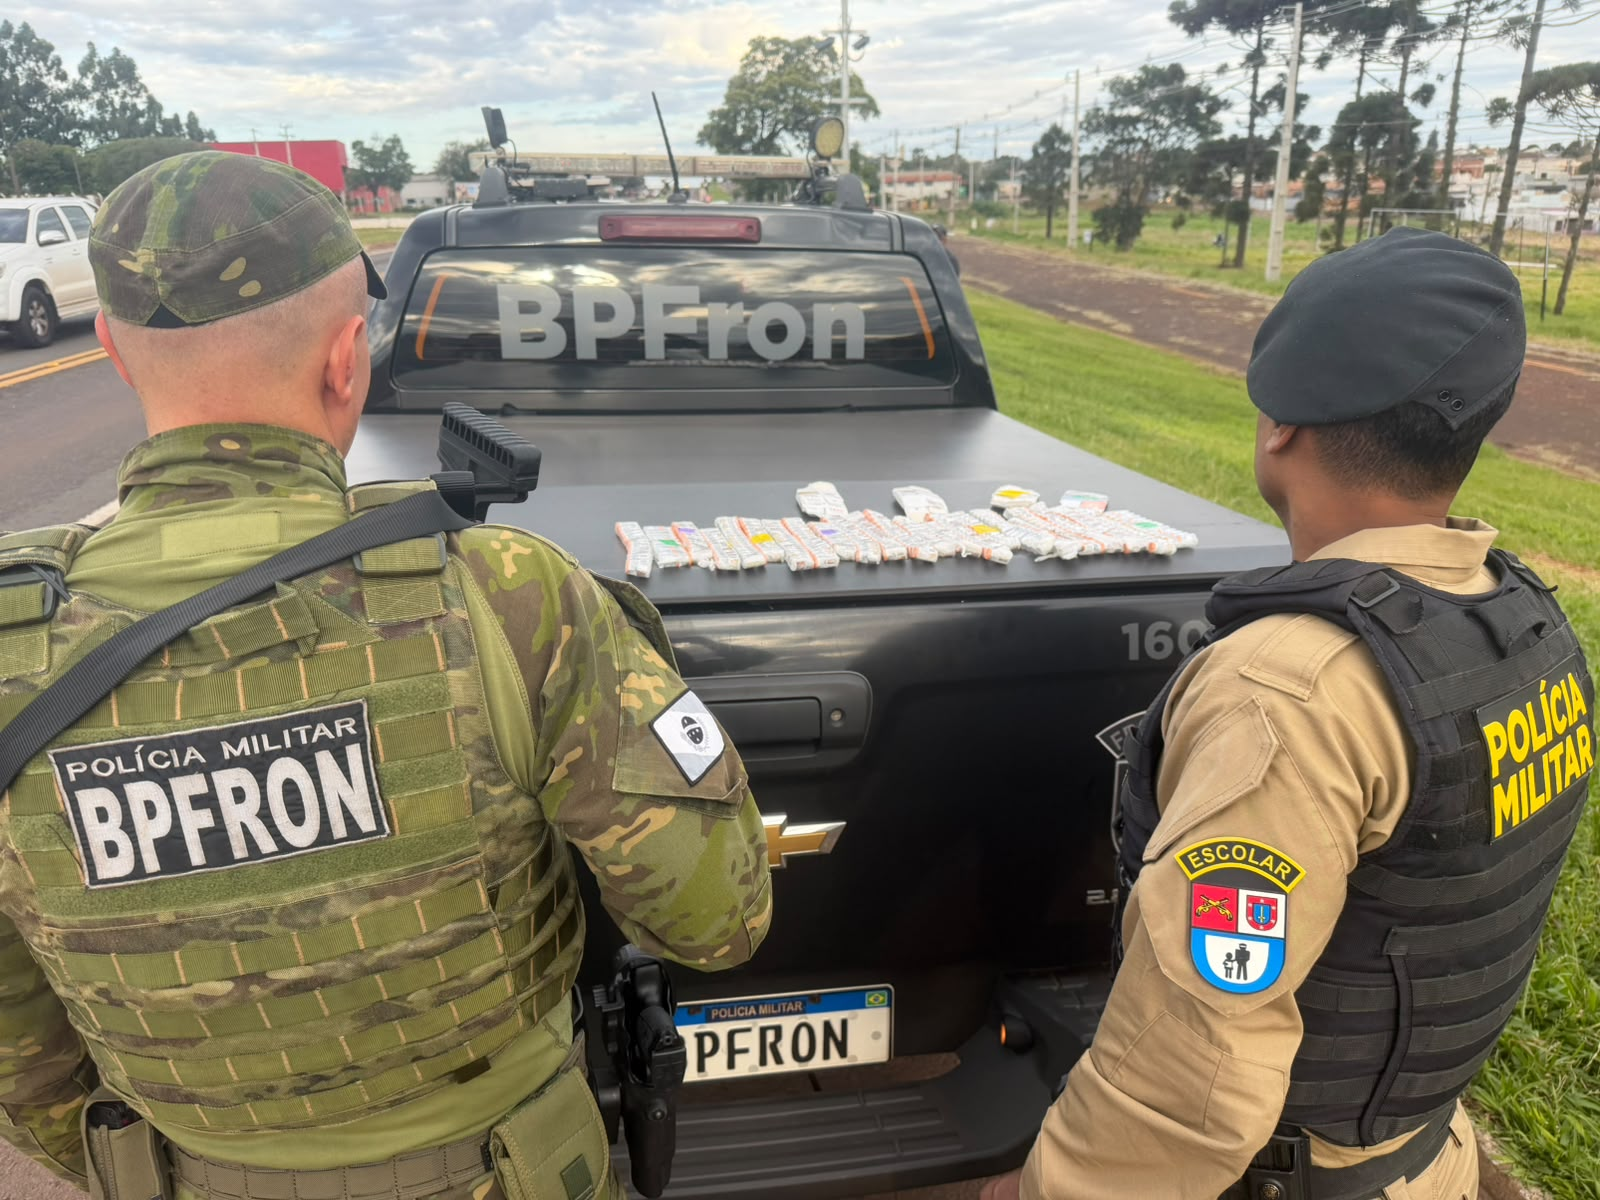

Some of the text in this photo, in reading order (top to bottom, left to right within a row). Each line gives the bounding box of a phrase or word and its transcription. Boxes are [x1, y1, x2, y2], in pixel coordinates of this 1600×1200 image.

[496, 284, 865, 361] BPFron
[65, 717, 358, 782] POLÍCIA MILITAR
[1482, 672, 1588, 779] POLÍCIA
[74, 743, 378, 880] BPFRON
[1492, 723, 1595, 839] MILITAR
[1187, 844, 1292, 881] ESCOLAR
[679, 1018, 848, 1073] PFRON
[711, 1001, 804, 1020] POLÍCIA MILITAR
